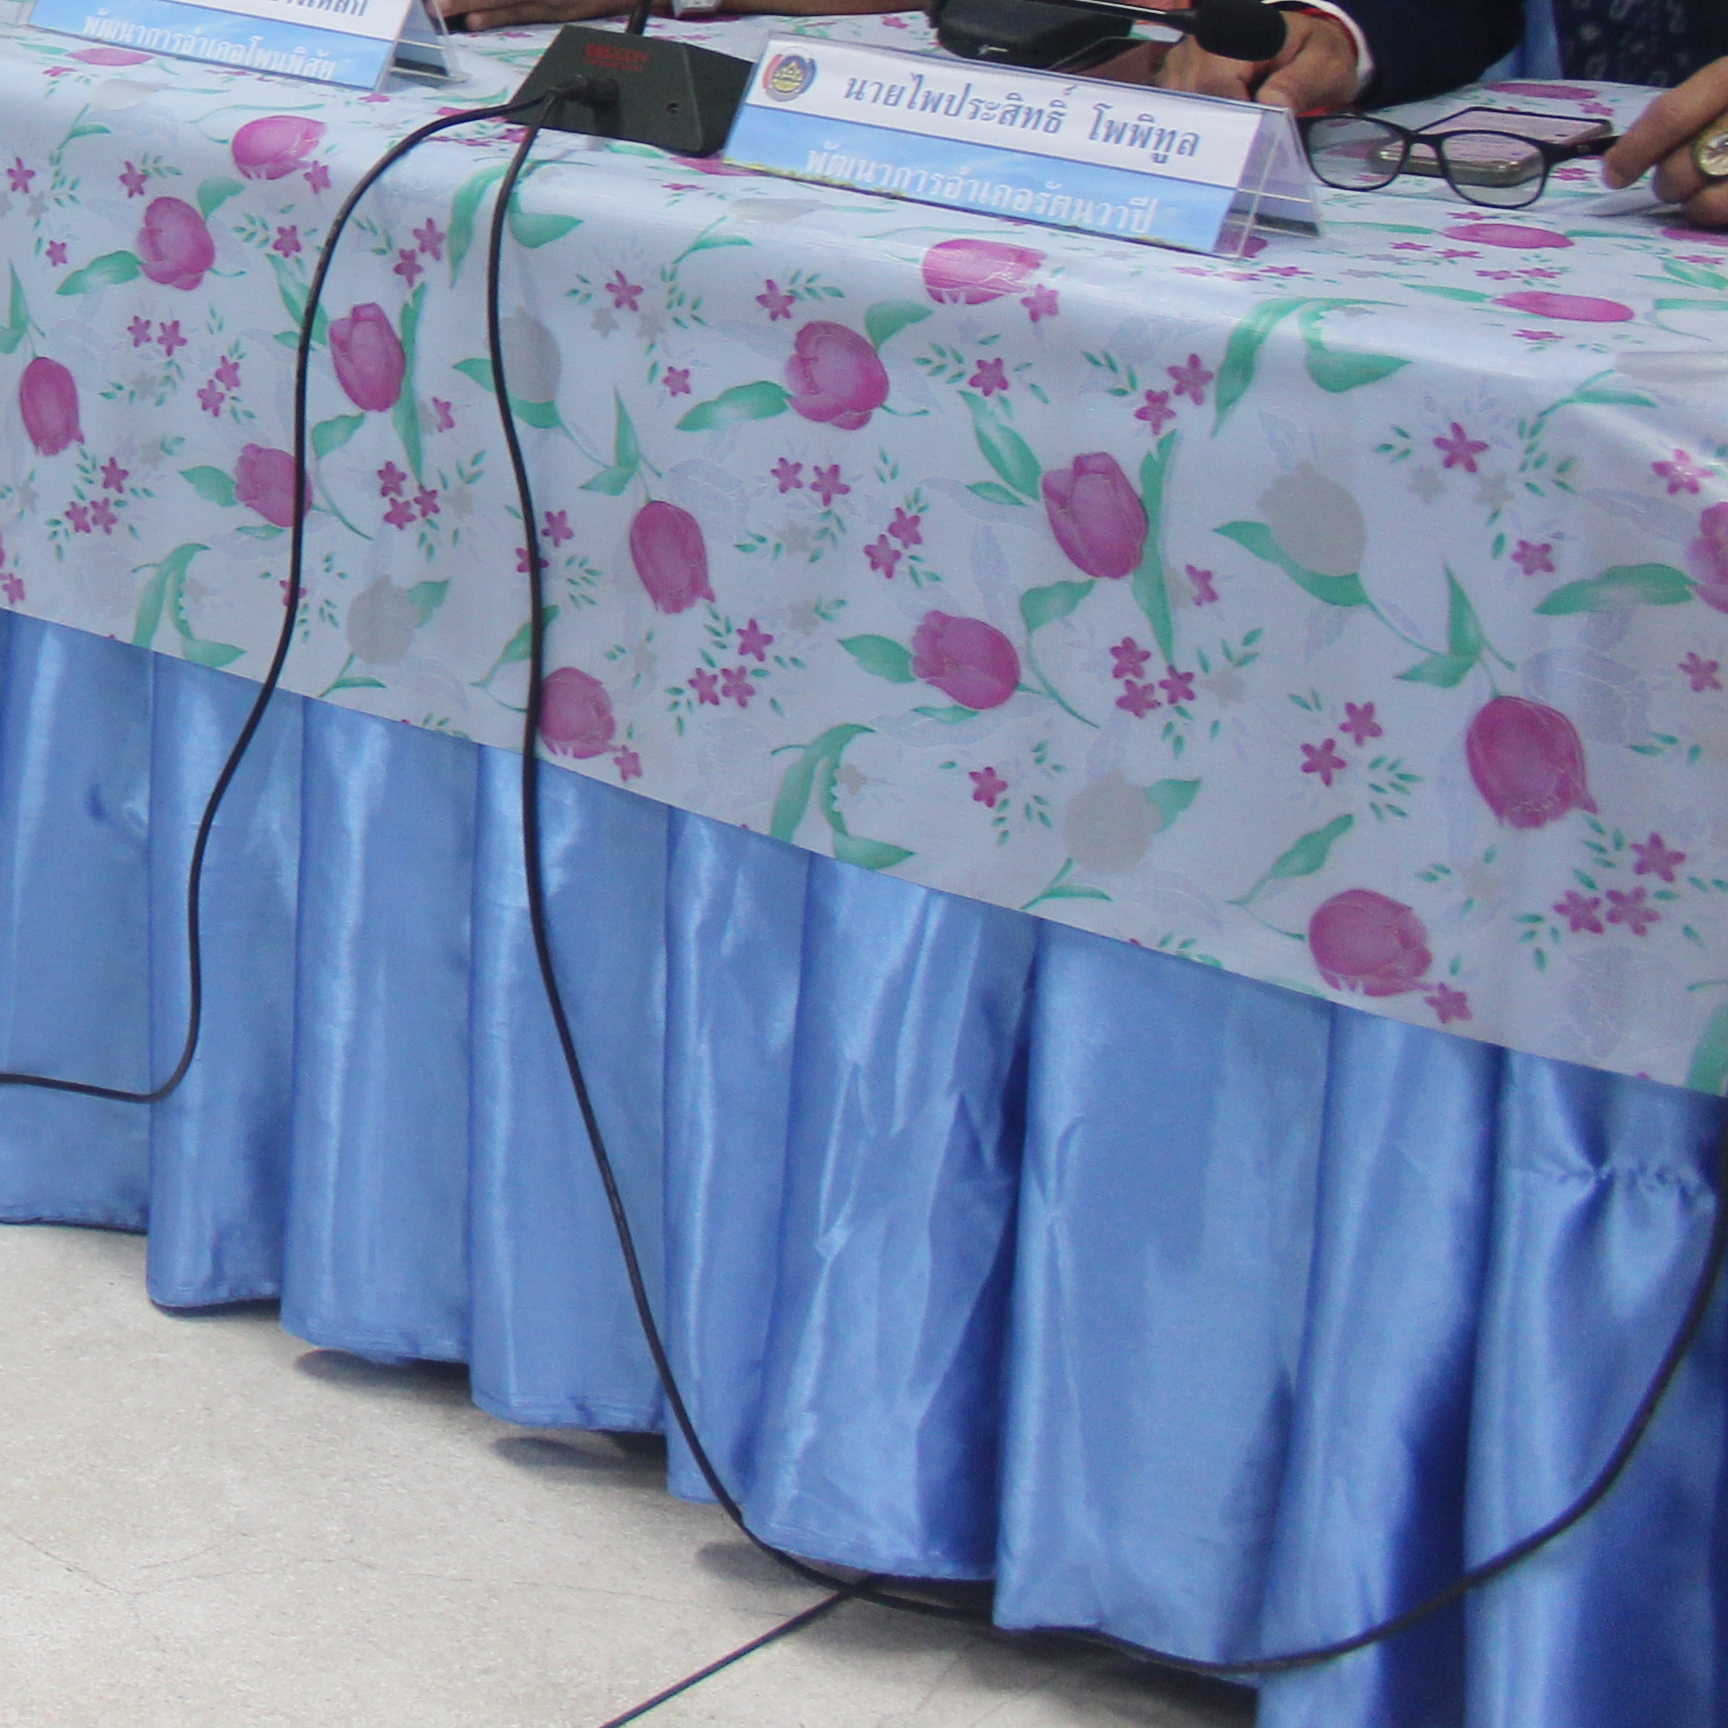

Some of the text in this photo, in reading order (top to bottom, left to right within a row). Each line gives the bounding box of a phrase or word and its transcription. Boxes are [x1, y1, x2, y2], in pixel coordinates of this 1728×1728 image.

[843, 72, 1201, 164] นายไพประสิทธิ์ โพพิทูล
